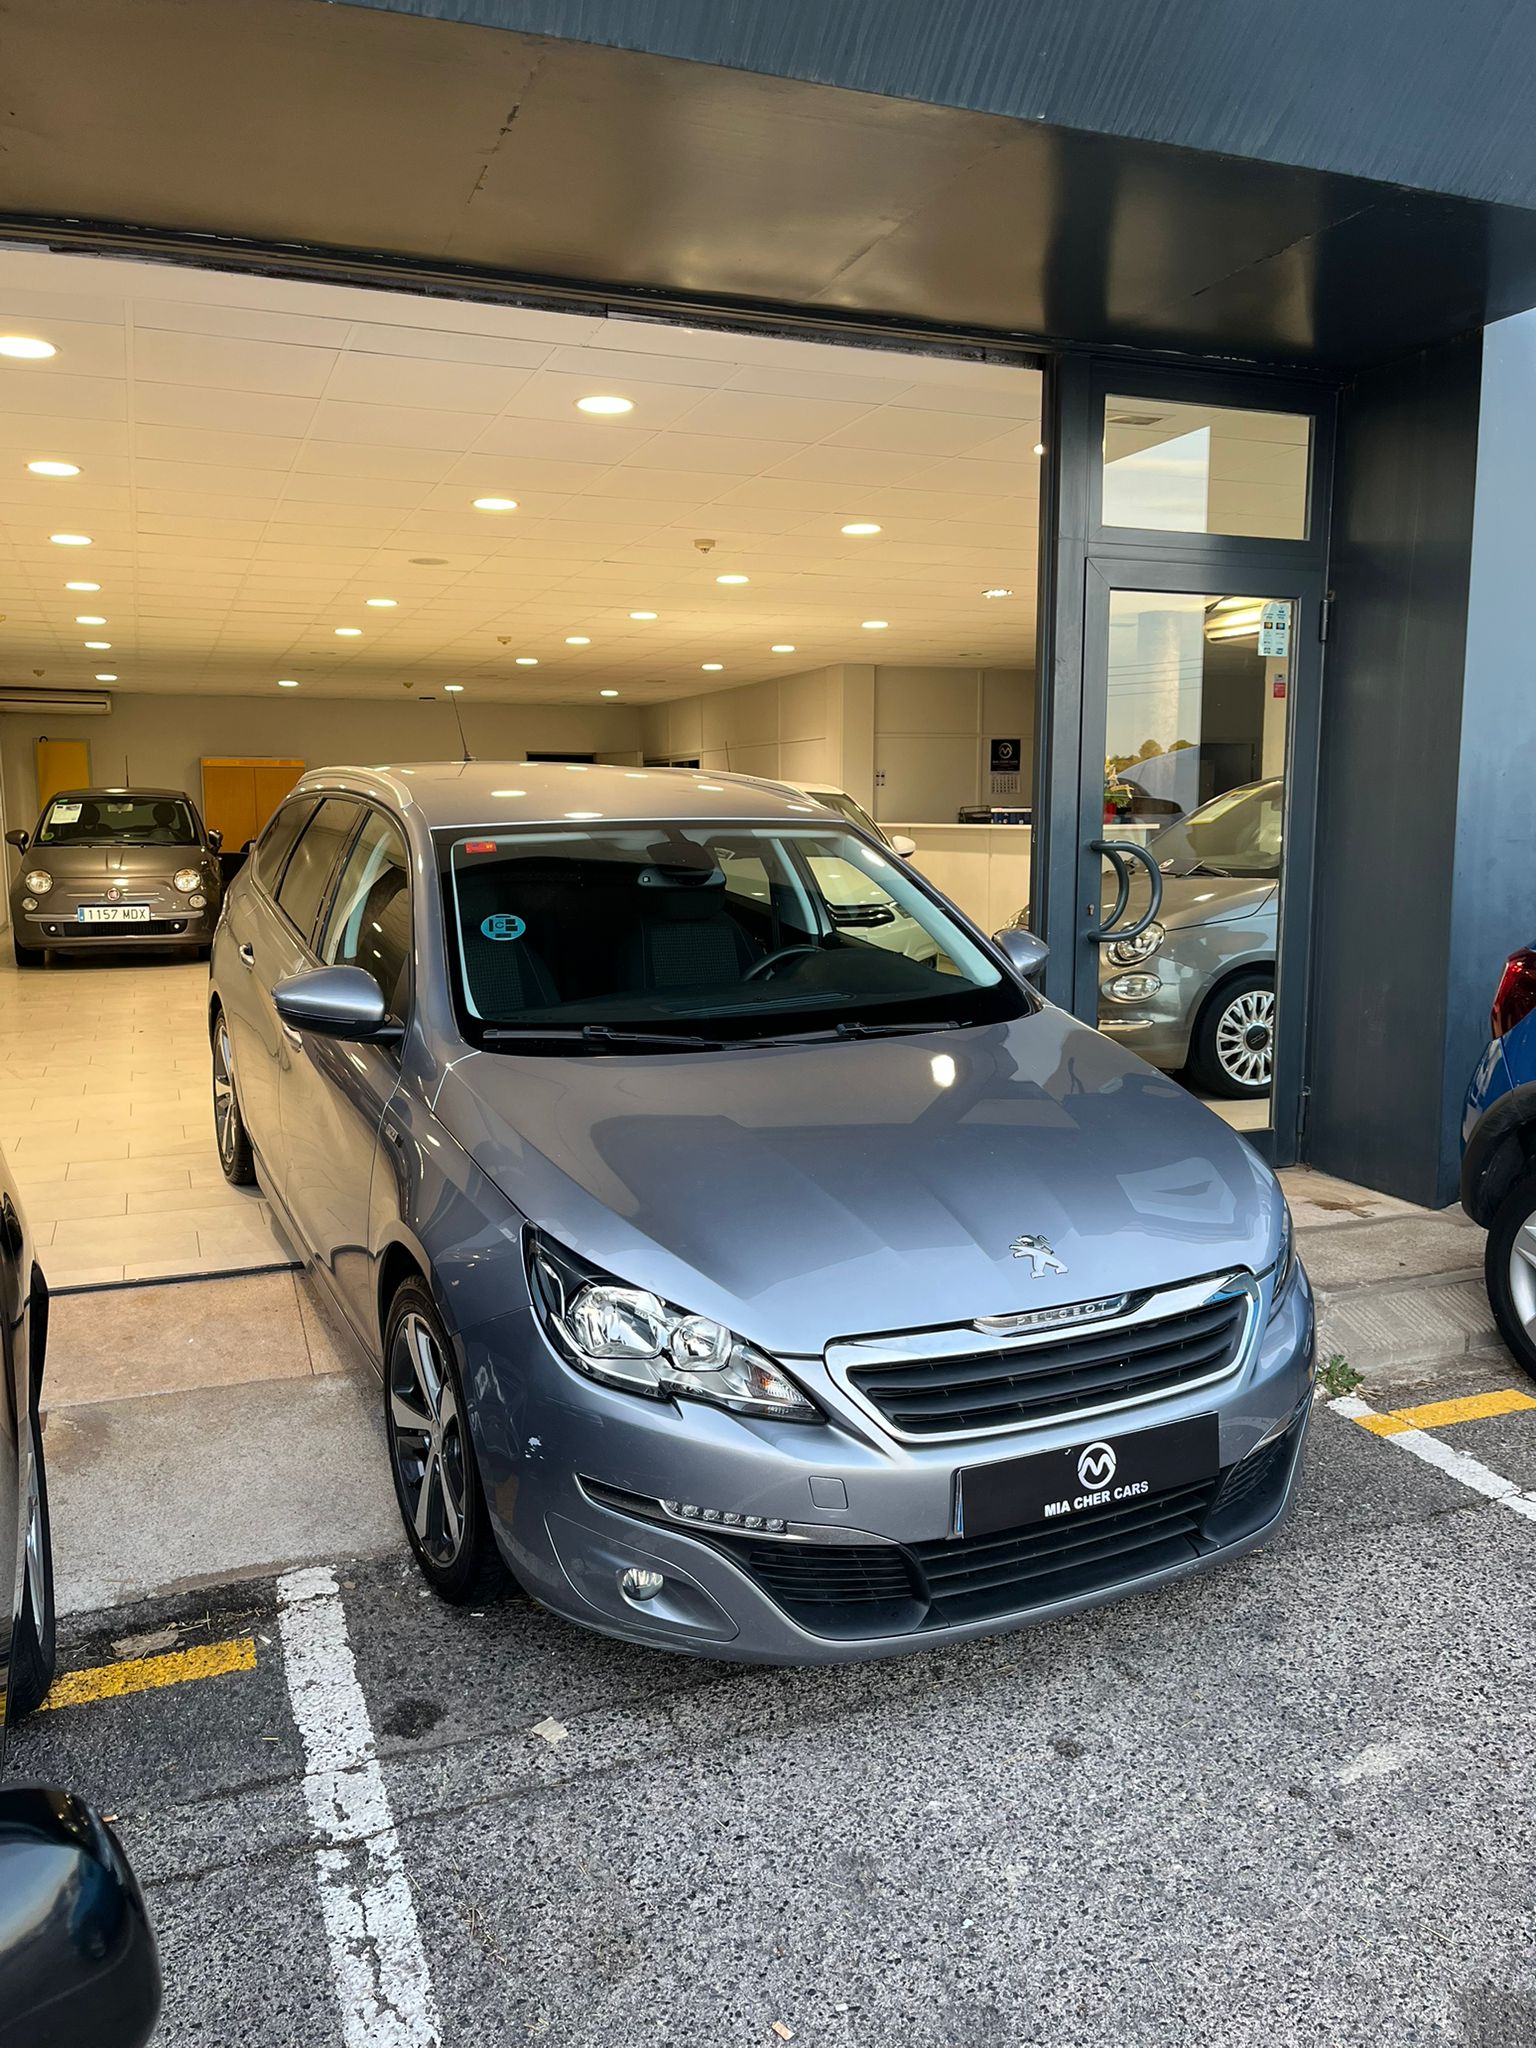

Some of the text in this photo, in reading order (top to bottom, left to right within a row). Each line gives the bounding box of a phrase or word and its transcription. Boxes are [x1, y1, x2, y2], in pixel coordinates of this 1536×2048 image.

[88, 908, 146, 920] 1157 MDX
[1044, 1481, 1149, 1517] MIA CHER CARS
